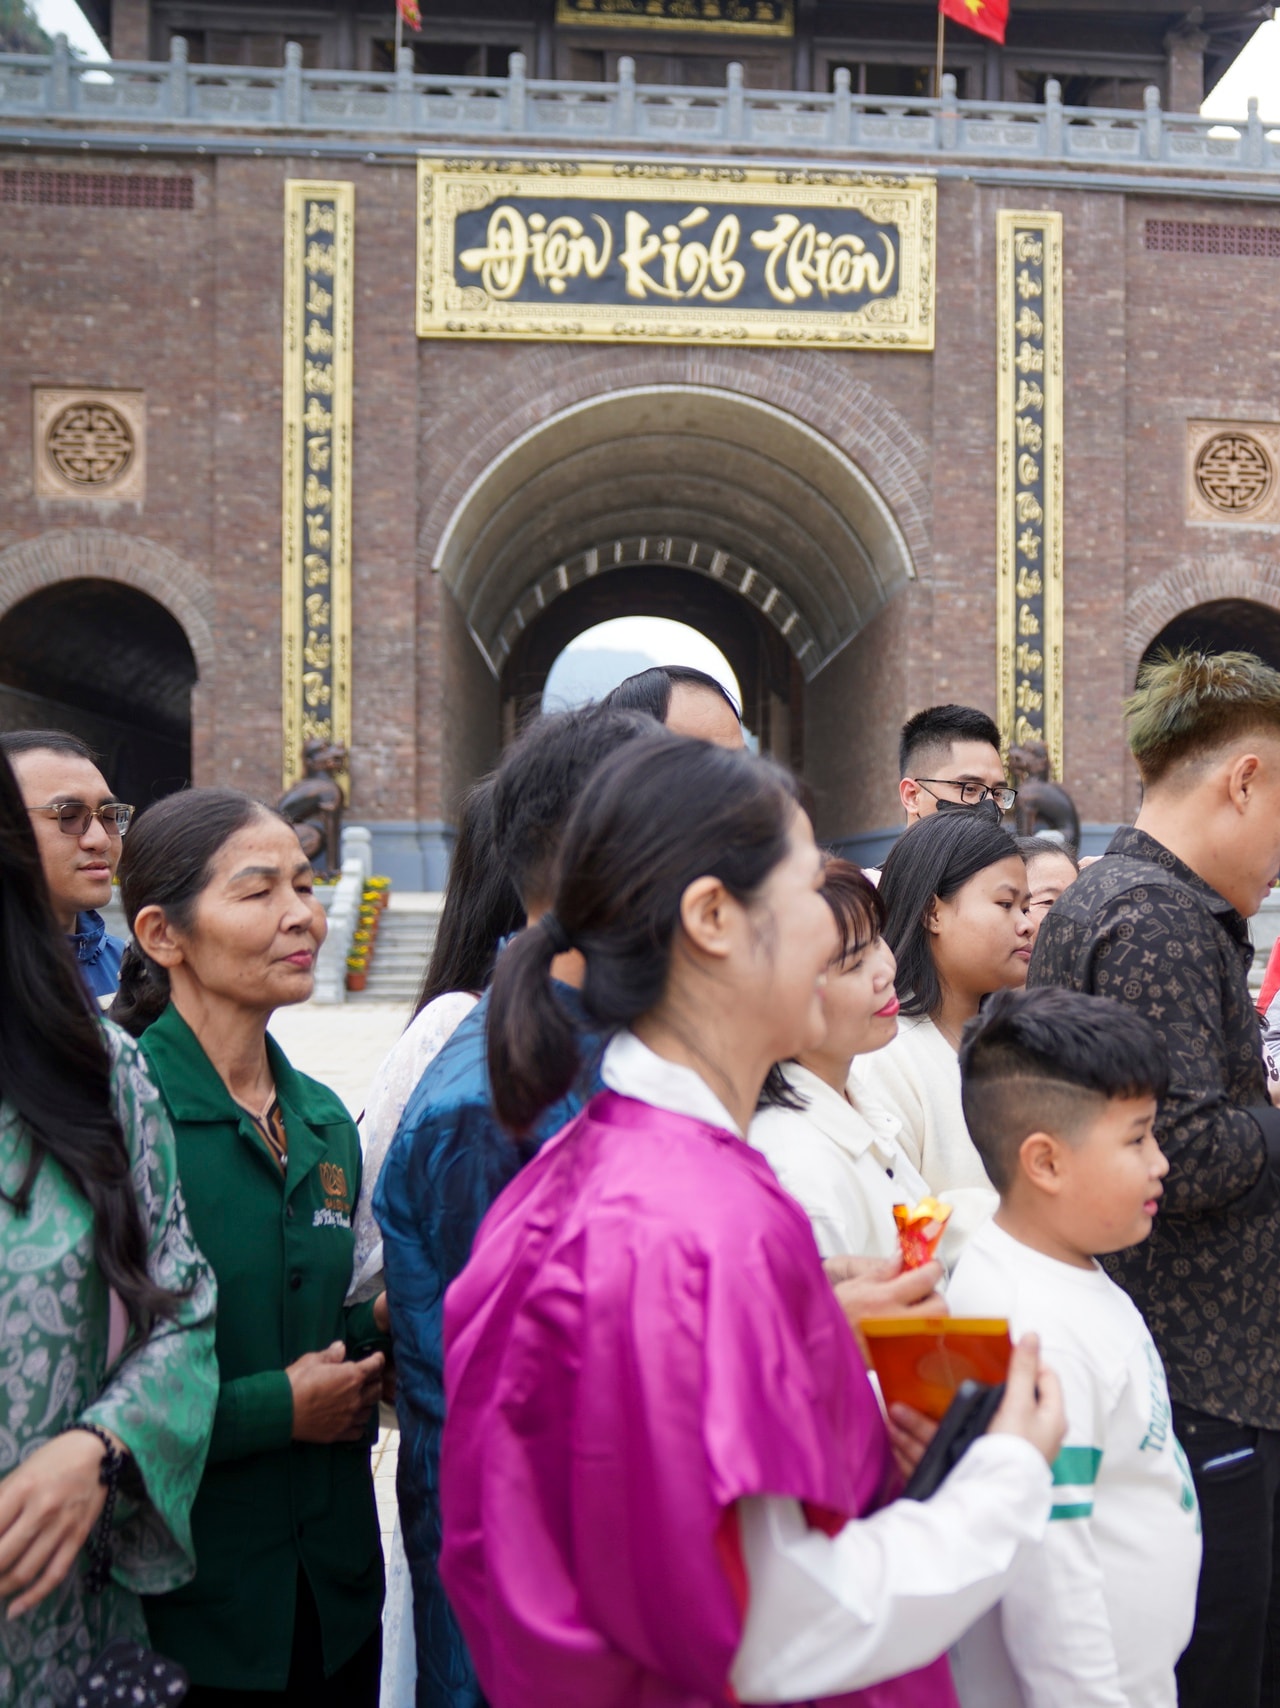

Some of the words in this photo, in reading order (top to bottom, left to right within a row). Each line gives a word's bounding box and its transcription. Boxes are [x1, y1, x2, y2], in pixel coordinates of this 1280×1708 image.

[459, 205, 613, 299] Điện
[618, 207, 746, 301] Kính
[750, 213, 896, 303] Thiên
